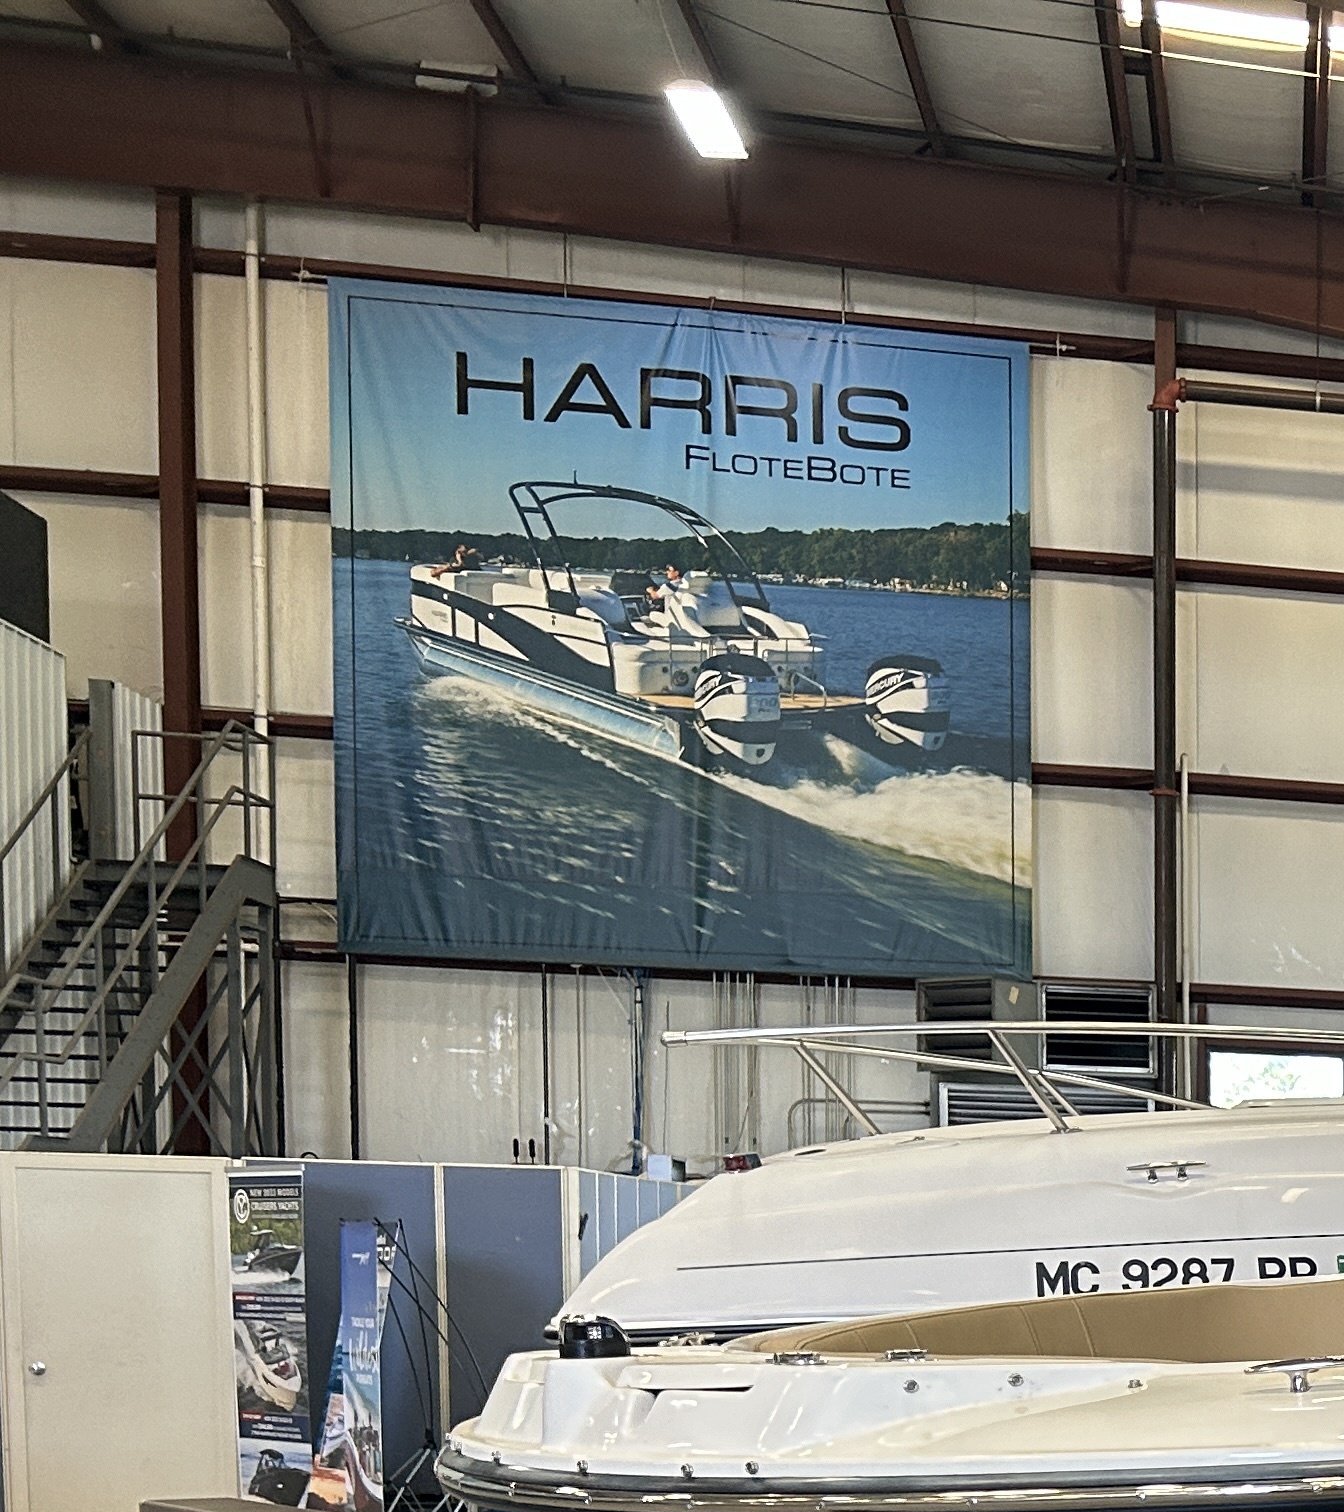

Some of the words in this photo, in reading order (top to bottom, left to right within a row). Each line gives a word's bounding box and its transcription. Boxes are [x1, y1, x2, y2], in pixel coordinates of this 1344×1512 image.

[456, 351, 912, 452] HARRIS
[1036, 1260, 1100, 1297] MC
[1122, 1257, 1235, 1290] 9287
